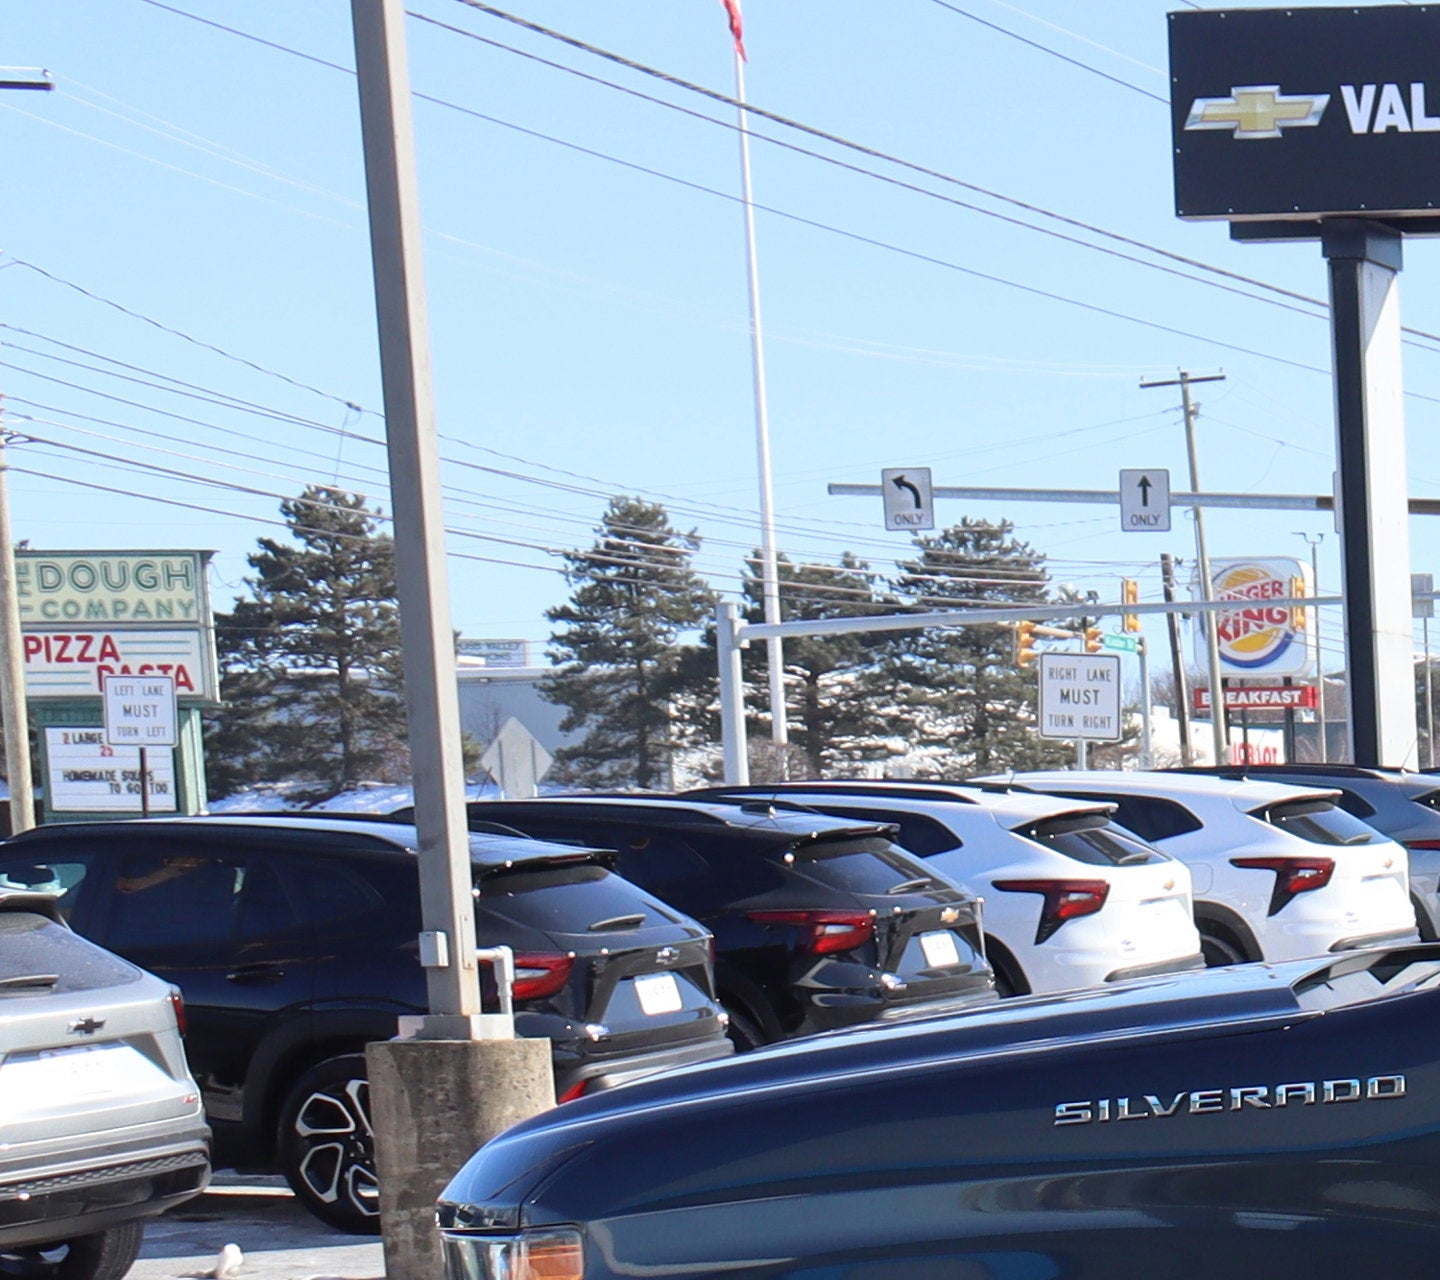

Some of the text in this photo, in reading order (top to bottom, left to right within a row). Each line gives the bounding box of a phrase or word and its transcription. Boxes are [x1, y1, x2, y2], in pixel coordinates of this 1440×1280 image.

[894, 513, 924, 526] ONLY
[1130, 514, 1160, 526] ONLY
[36, 560, 194, 592] DOUGH
[40, 599, 196, 619] COMPANY
[1216, 606, 1288, 646] KING
[23, 635, 120, 663] PIZZA
[1048, 667, 1112, 681] RIGHT LANE
[114, 684, 164, 696] LEFT LANE
[1060, 688, 1100, 705] MUST
[1201, 690, 1301, 705] BEAKFAST
[122, 704, 158, 718] MUST
[1049, 714, 1111, 728] TURN RIGHT
[72, 733, 104, 744] LARGE
[117, 726, 166, 737] TURN LEFT
[63, 769, 116, 781] HOMEMADE
[122, 769, 154, 781] SOUS
[109, 783, 121, 794] TO
[1054, 1074, 1406, 1126] SILVERADO
